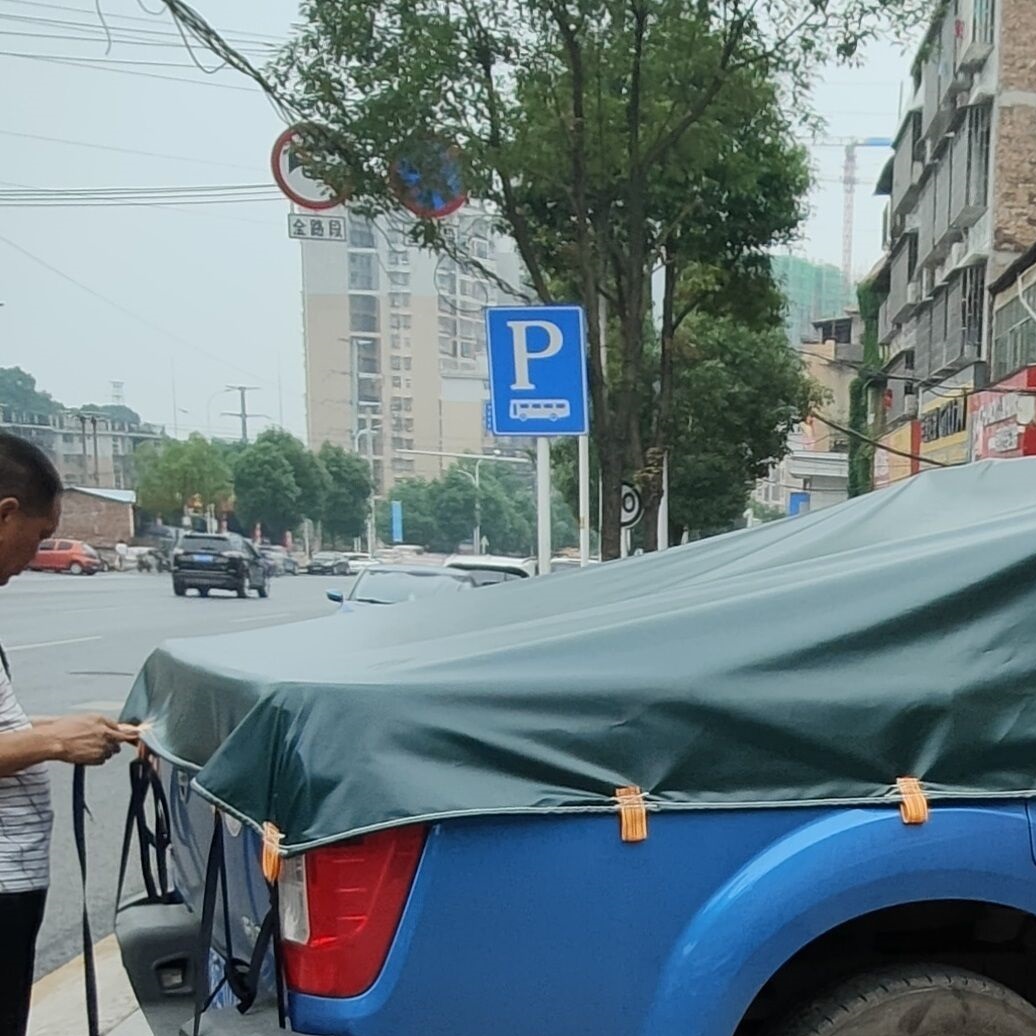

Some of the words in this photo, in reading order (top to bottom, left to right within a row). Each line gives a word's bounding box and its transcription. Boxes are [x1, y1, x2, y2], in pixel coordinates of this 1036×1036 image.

[293, 219, 343, 238] 全路段
[507, 320, 564, 391] P
